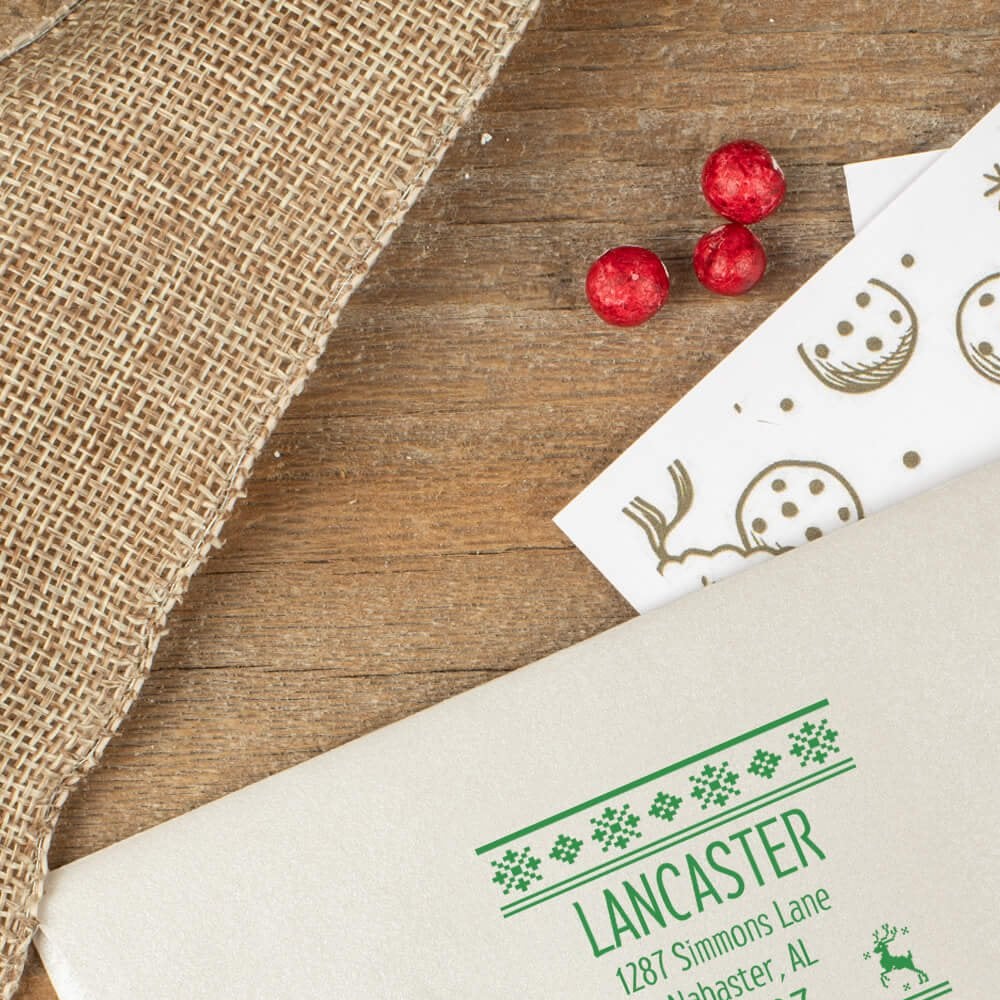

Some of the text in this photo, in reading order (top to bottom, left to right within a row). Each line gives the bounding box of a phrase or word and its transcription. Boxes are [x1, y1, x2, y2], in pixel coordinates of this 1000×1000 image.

[572, 808, 827, 957] LANCASTER
[616, 888, 832, 995] 1287 Simmons Lane
[787, 939, 818, 972] AL
